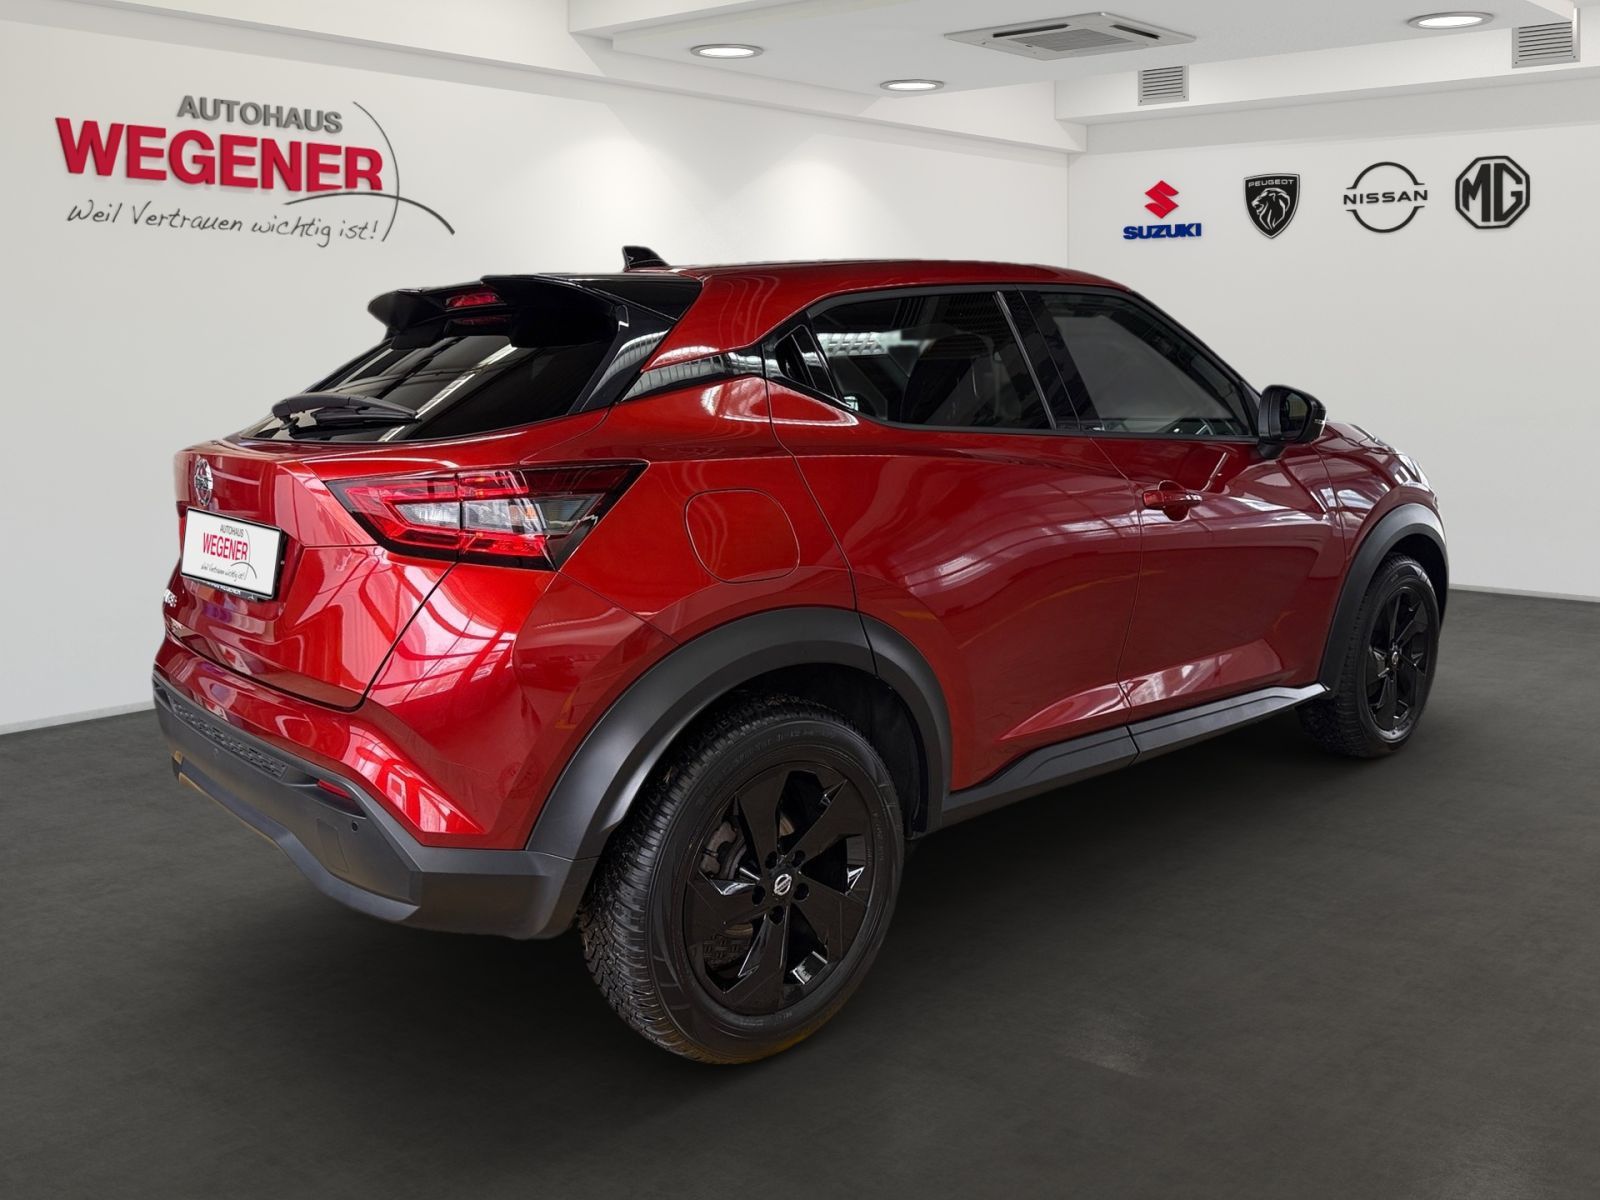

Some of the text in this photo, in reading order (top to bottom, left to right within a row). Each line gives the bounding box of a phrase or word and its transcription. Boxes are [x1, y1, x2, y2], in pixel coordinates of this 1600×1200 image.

[176, 94, 343, 134] AUTOHAUS
[55, 117, 384, 193] WEGENER
[1248, 178, 1295, 188] PEUGEOT
[1343, 189, 1429, 206] NISSAN
[1461, 162, 1524, 223] MG
[67, 200, 379, 248] Weil Vertrauen wichtig ist!
[1122, 222, 1202, 240] SUZUKI
[203, 531, 249, 561] WEGENER
[219, 524, 244, 538] AUTOHAUS
